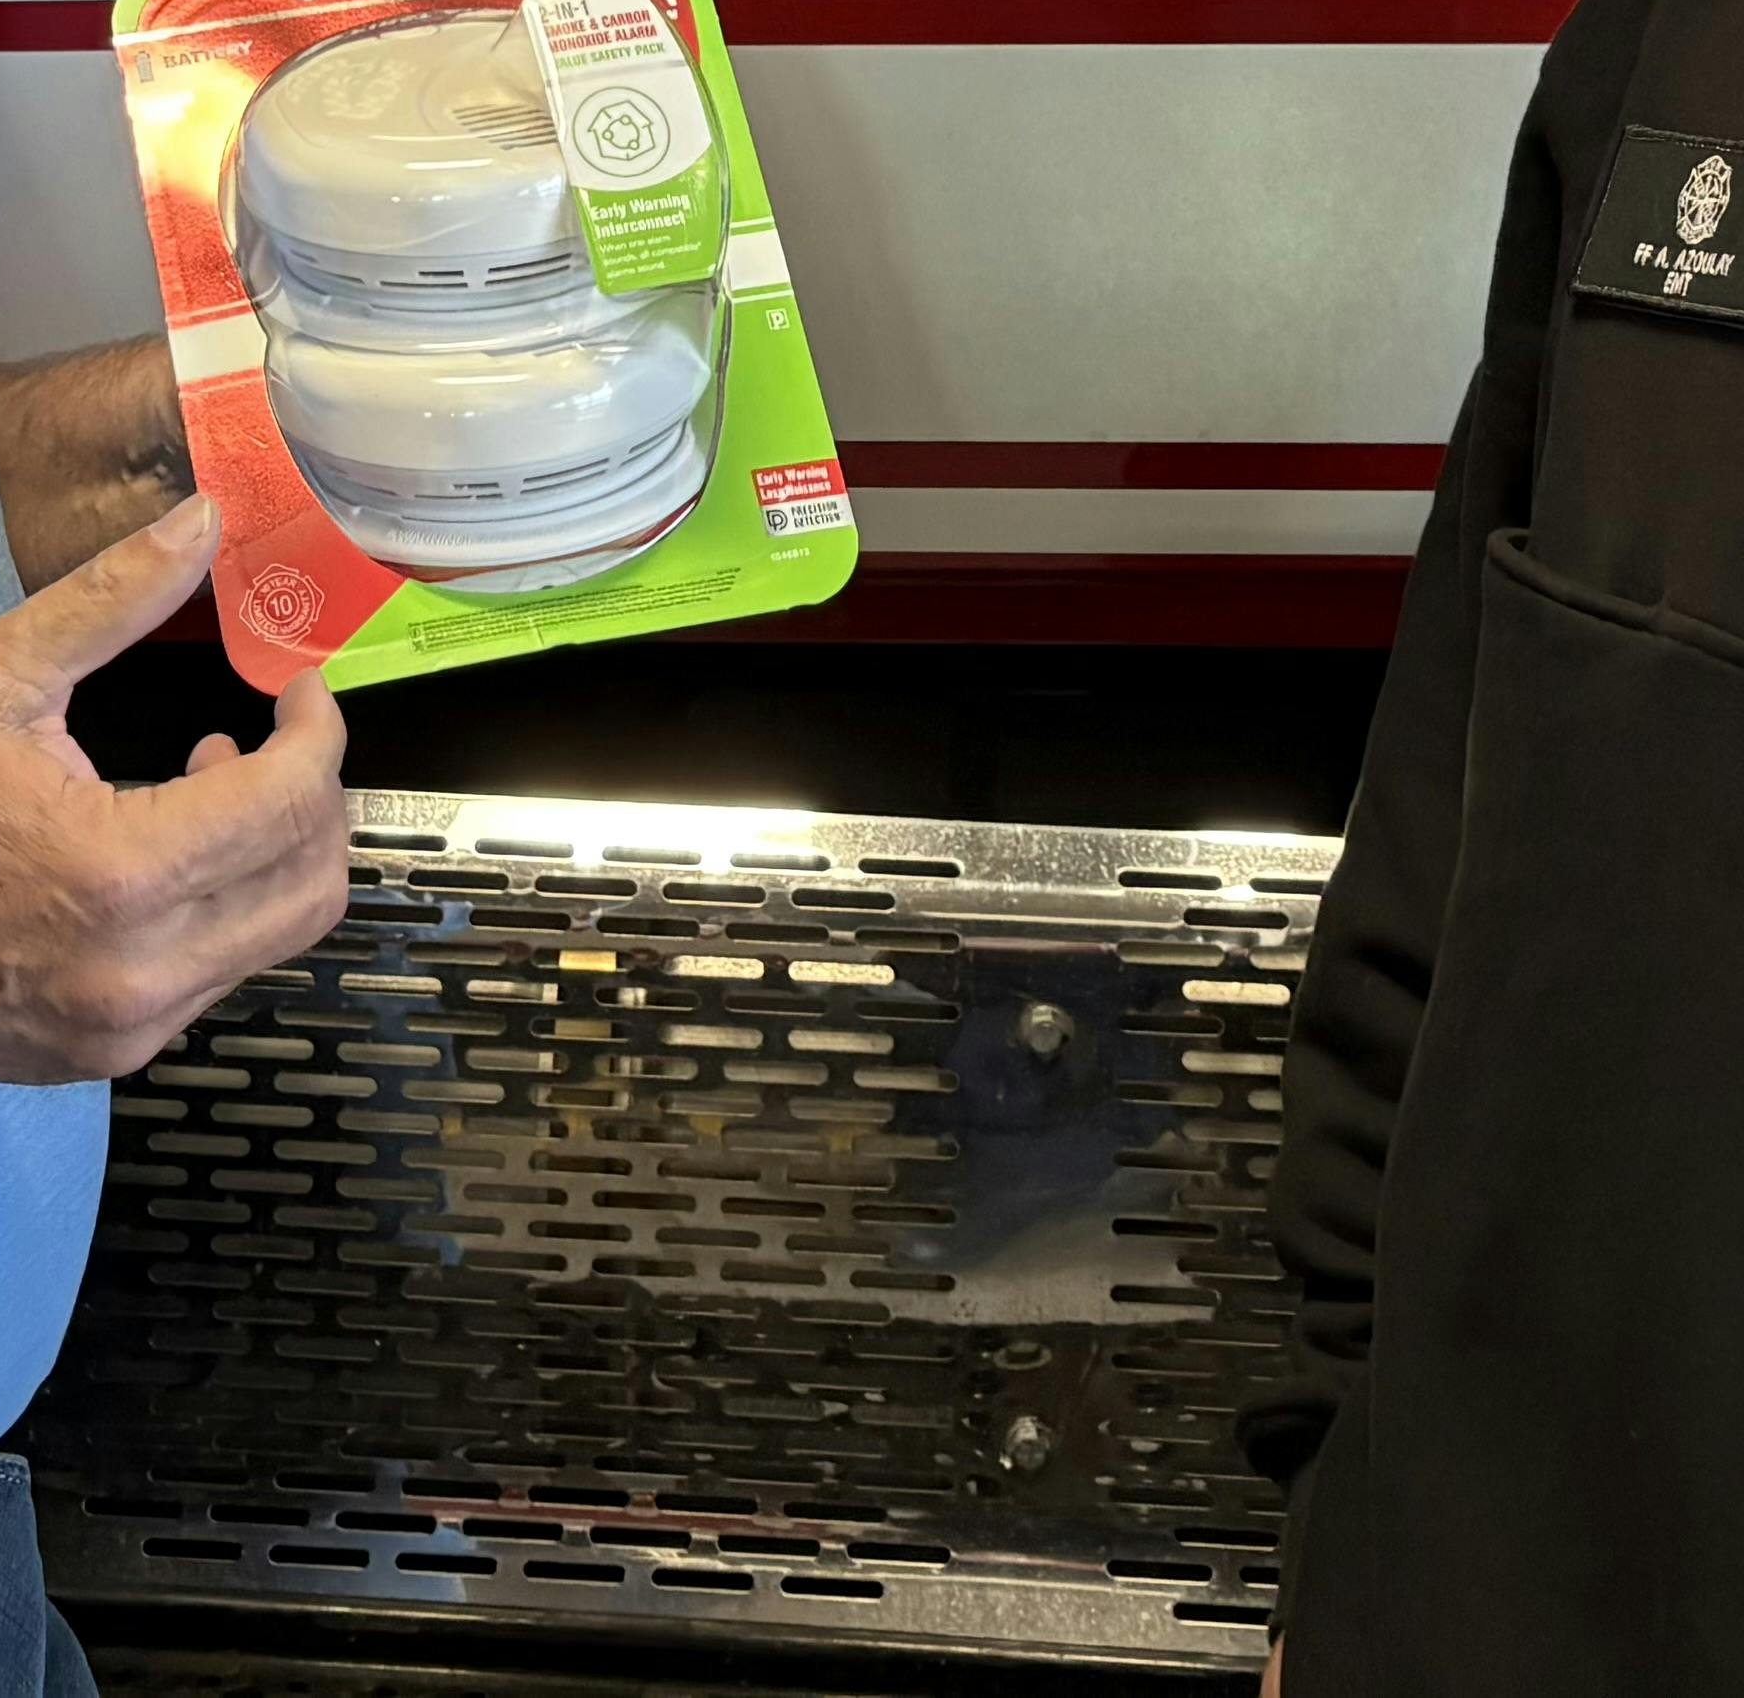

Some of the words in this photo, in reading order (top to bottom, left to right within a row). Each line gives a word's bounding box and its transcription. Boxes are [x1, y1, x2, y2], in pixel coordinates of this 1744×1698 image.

[539, 0, 590, 23] 2-IN-1
[591, 18, 599, 30] &
[602, 9, 651, 28] CARBON
[615, 25, 658, 42] ALARM
[162, 39, 254, 69] BATTERY
[591, 46, 632, 63] SAFETY
[635, 42, 665, 56] PACK
[590, 202, 627, 222] Early
[629, 193, 691, 214] Warning
[594, 209, 686, 239] Interconnect
[1633, 242, 1654, 267] FF
[1672, 248, 1736, 277] AZOULAY
[1662, 270, 1693, 297] EMT
[756, 470, 783, 486] Early
[784, 465, 829, 481] Warning
[269, 594, 294, 617] 10
